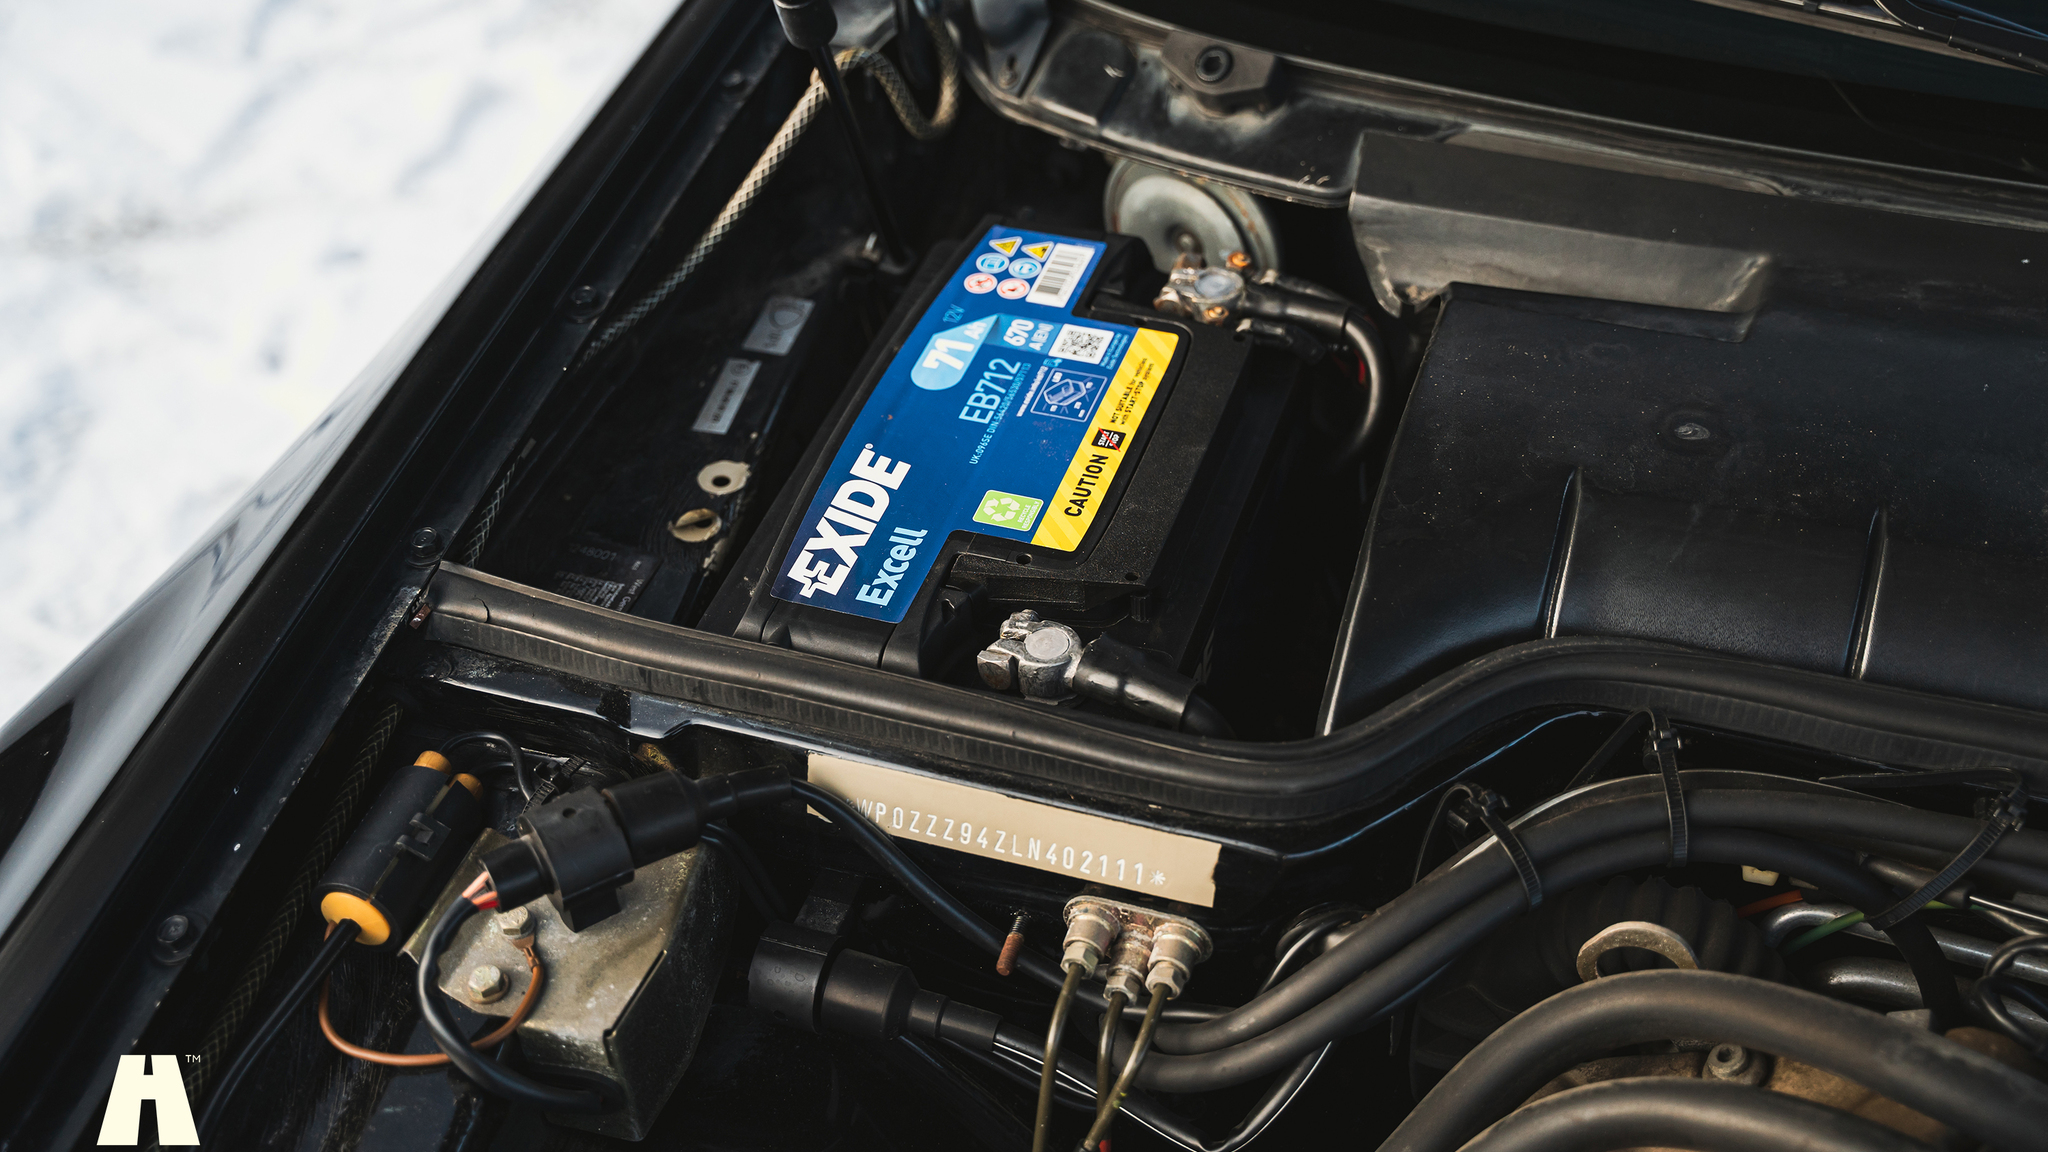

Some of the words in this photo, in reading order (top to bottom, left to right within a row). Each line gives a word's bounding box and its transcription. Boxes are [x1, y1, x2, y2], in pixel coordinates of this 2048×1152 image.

[922, 338, 975, 370] 71
[964, 321, 987, 340] Ah
[1003, 319, 1034, 347] 670
[958, 358, 1021, 424] EB712
[1110, 412, 1120, 423] NOT
[1115, 387, 1132, 411] SUITABLE
[1125, 381, 1144, 413] START-STOP
[1064, 454, 1109, 517] CAUTION
[787, 447, 912, 599] EXIDE
[1017, 504, 1031, 523] RECYCLE
[1021, 501, 1040, 529] RESPONSIBLY
[855, 526, 929, 606] Excell
